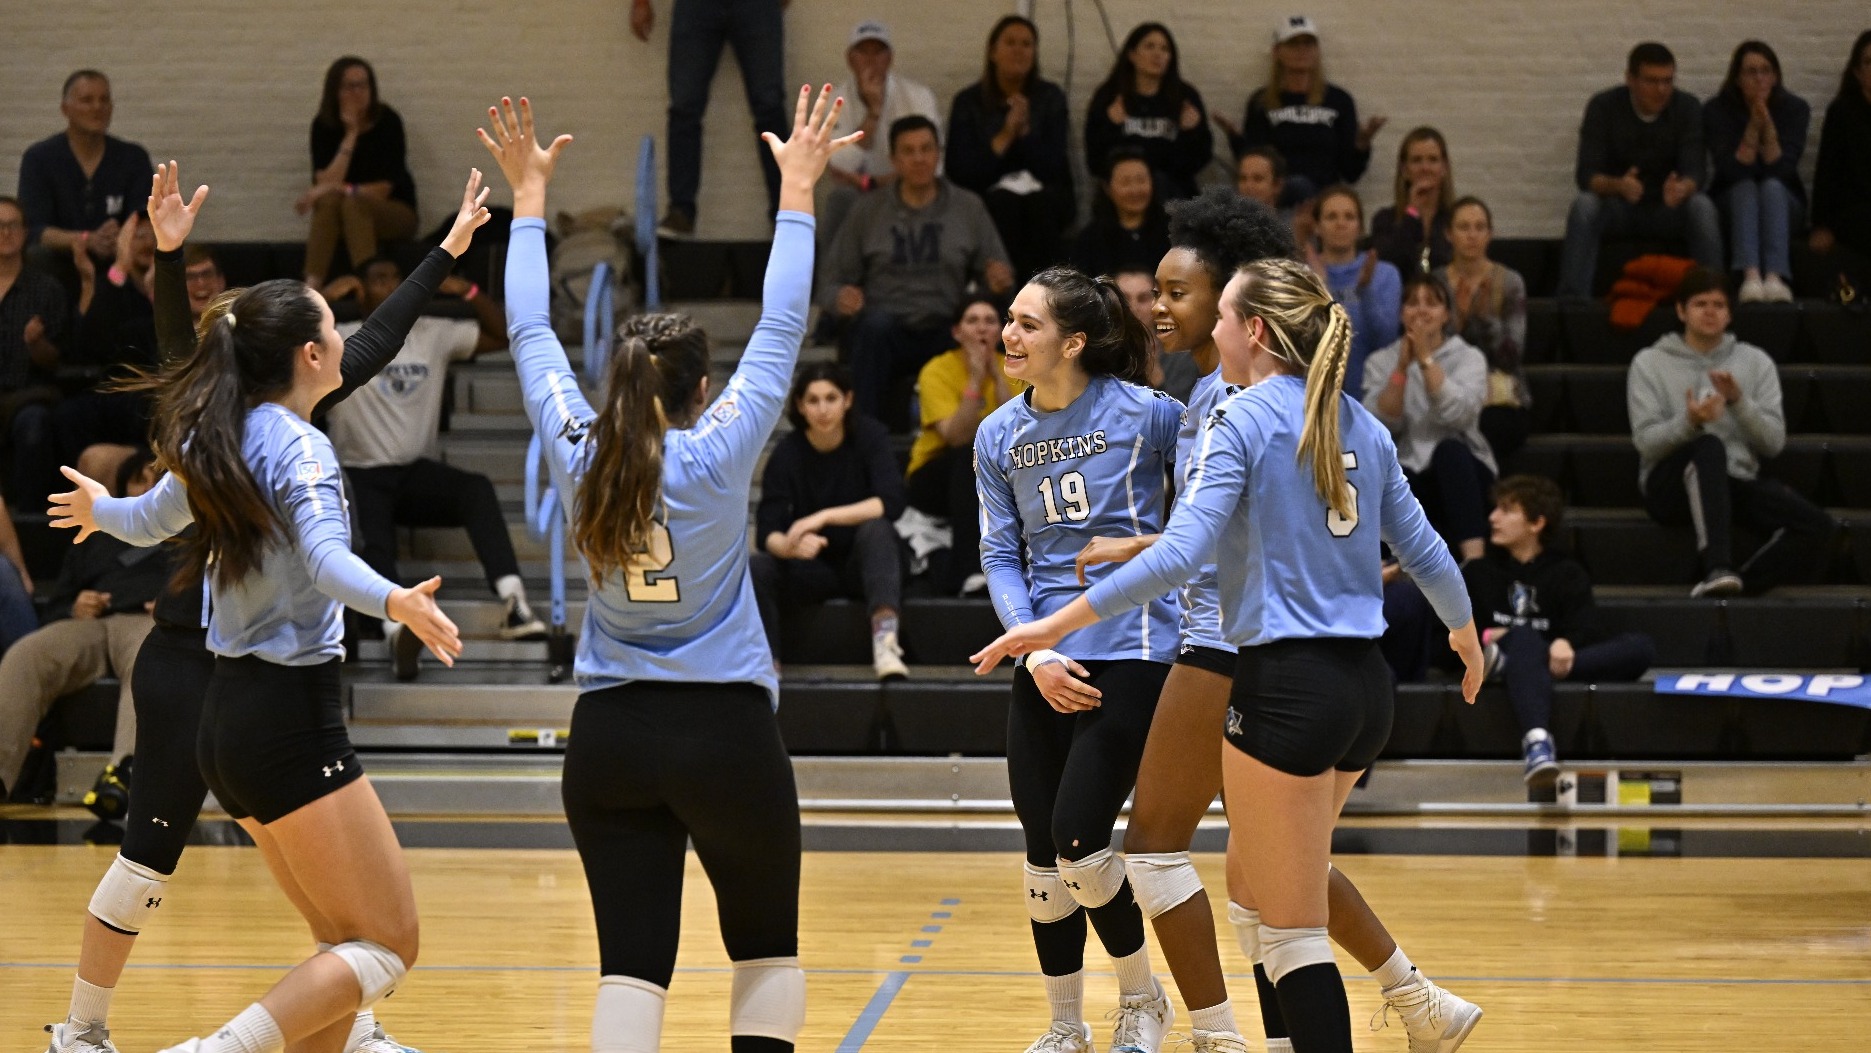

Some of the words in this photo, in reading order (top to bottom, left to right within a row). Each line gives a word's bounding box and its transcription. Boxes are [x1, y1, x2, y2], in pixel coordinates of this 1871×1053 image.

[1009, 430, 1107, 470] HOPKINS
[1037, 470, 1090, 525] 19
[622, 518, 681, 602] 2
